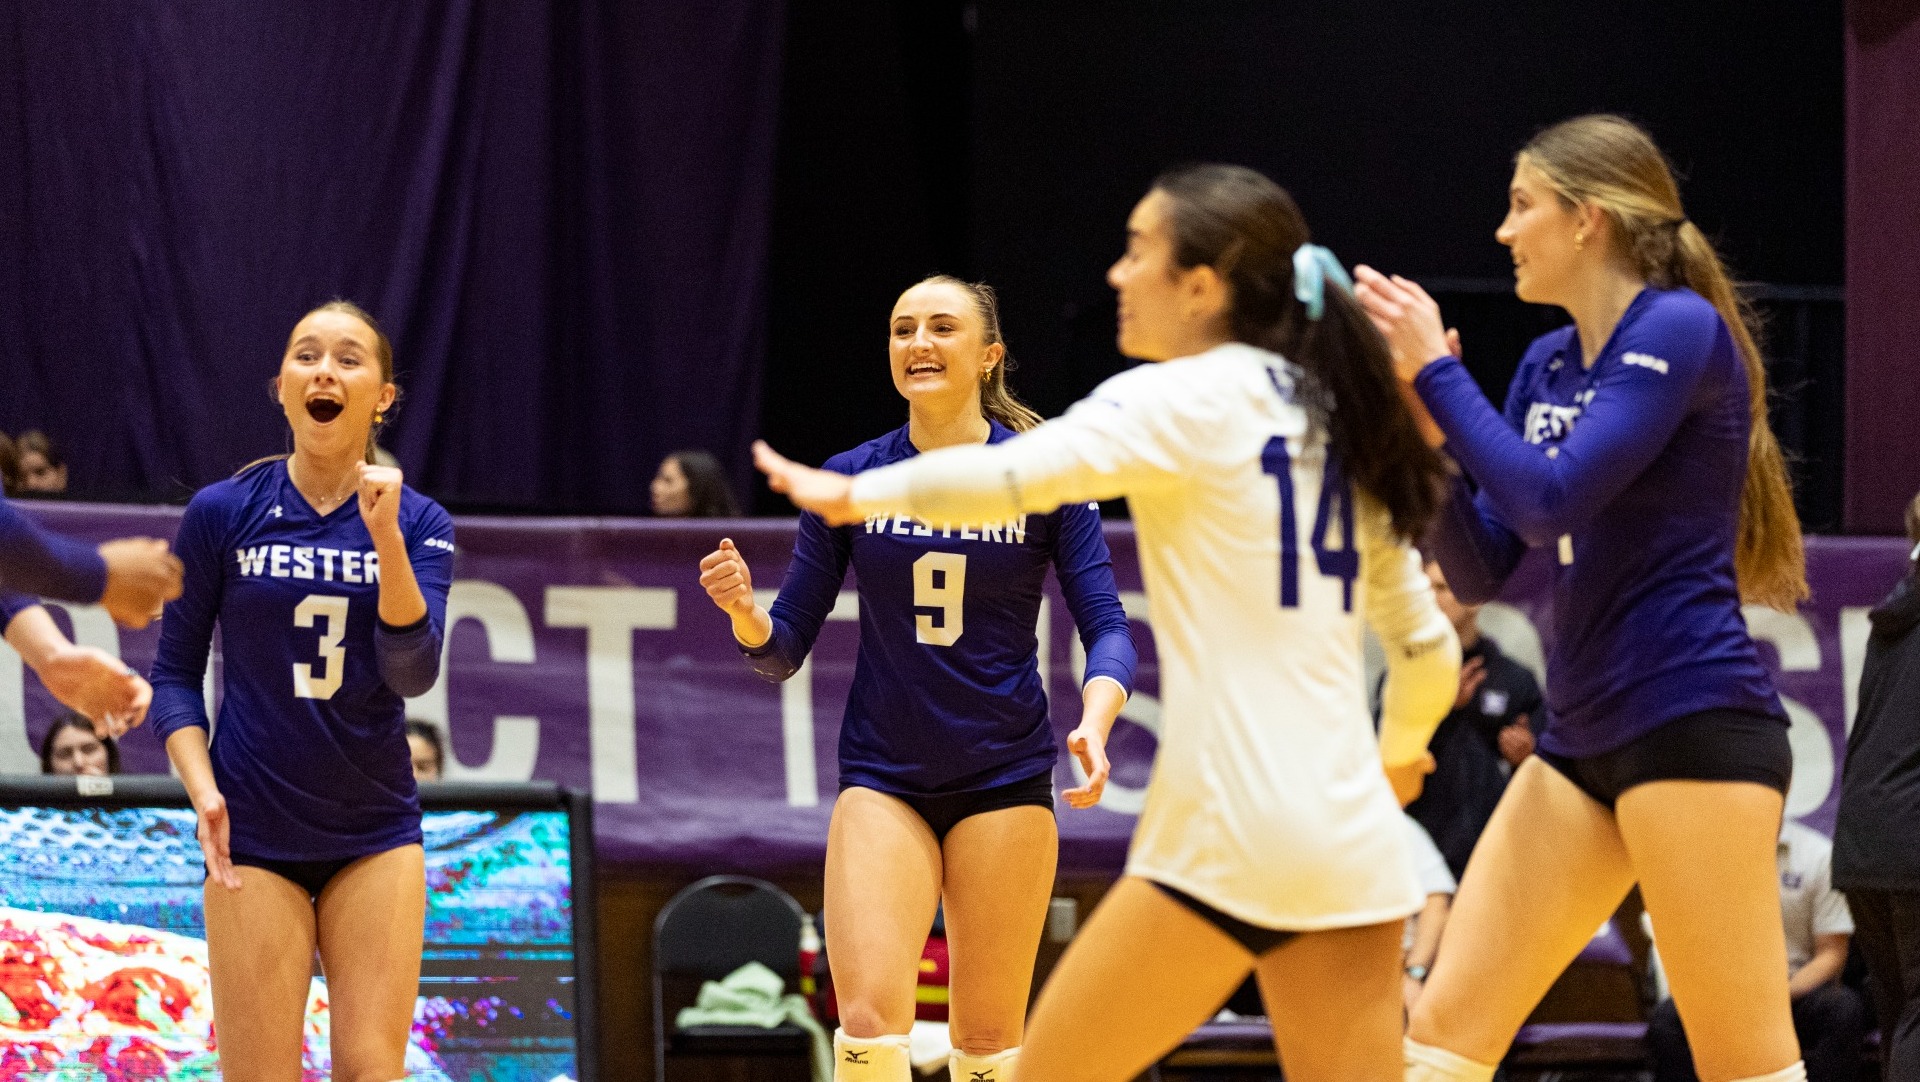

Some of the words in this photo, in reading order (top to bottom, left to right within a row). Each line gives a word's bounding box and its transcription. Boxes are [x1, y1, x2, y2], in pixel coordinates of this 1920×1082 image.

[236, 545, 380, 583] WESTER
[1261, 436, 1359, 614] 14
[293, 594, 349, 700] 3
[913, 551, 967, 647] 9
